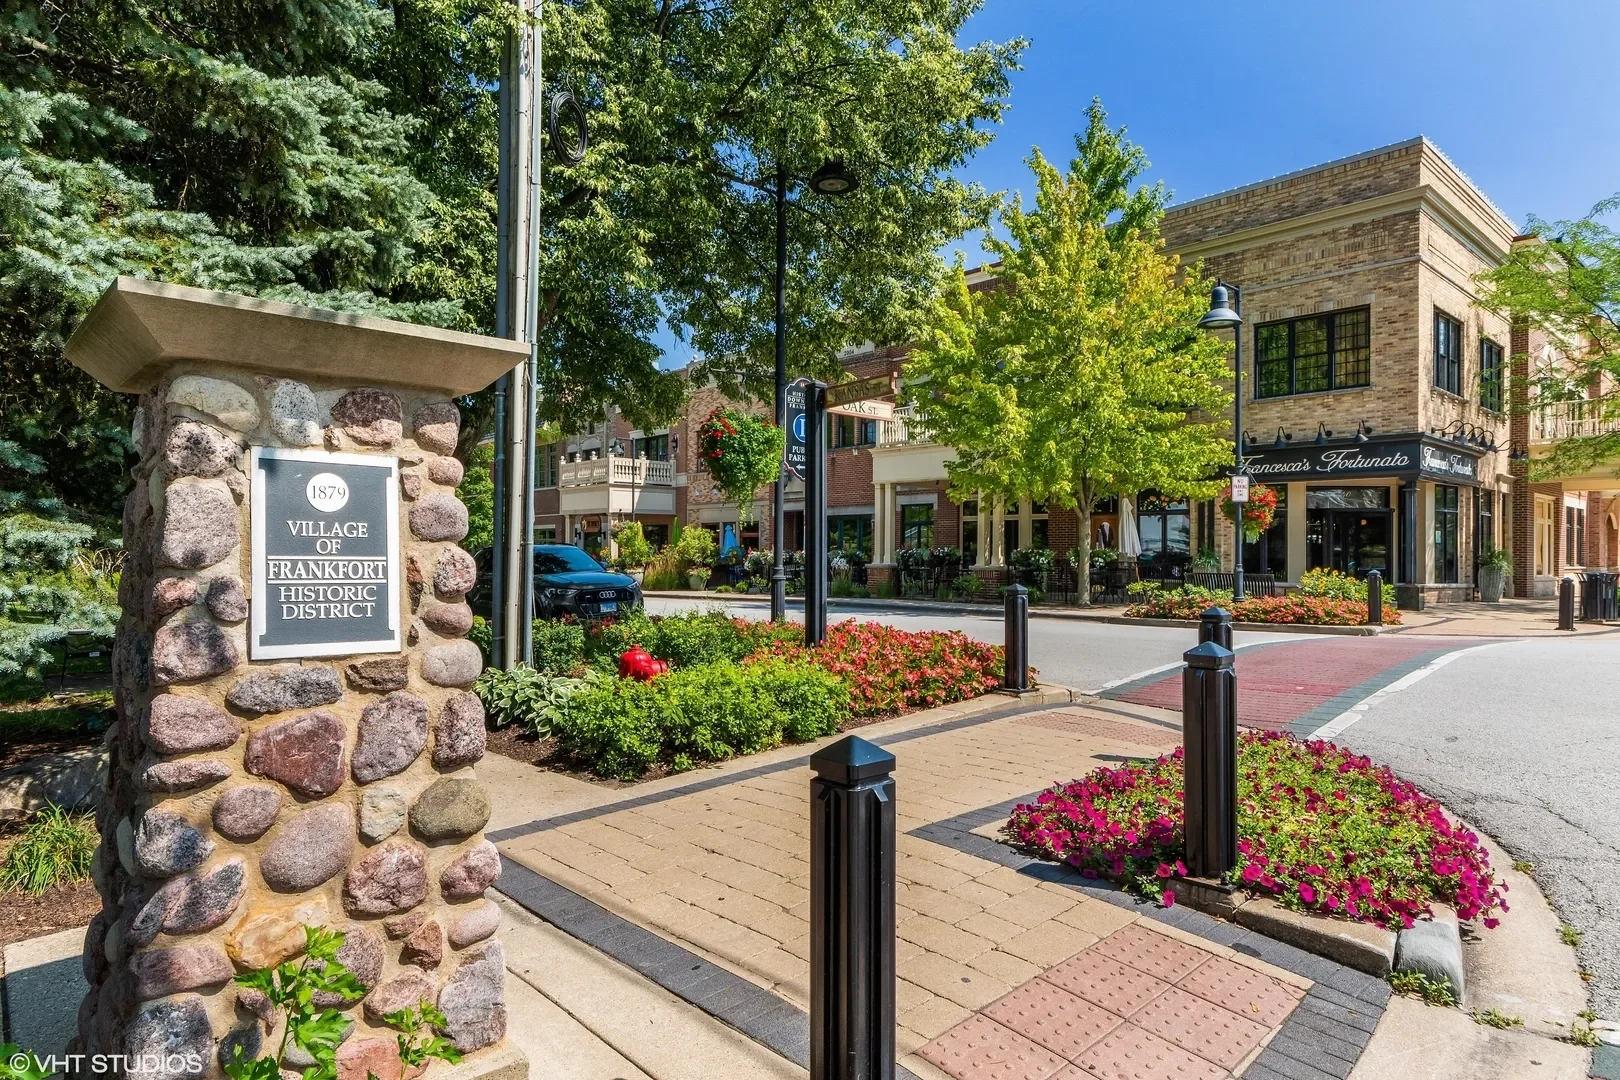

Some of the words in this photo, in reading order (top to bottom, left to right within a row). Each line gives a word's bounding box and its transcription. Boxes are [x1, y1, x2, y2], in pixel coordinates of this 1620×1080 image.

[835, 382, 870, 401] KANSAS
[787, 396, 805, 404] DOWN
[843, 401, 866, 413] OAK
[868, 406, 879, 415] ST.
[792, 446, 805, 454] PUB
[1226, 455, 1312, 476] Francesca's
[1316, 448, 1410, 472] Fortunato
[311, 485, 346, 500] 1879
[287, 520, 369, 538] VILLAGE
[316, 539, 341, 554] OF
[267, 560, 387, 579] FRANKFORT
[279, 586, 377, 602] HISTORIC
[281, 603, 375, 620] DISTRICT
